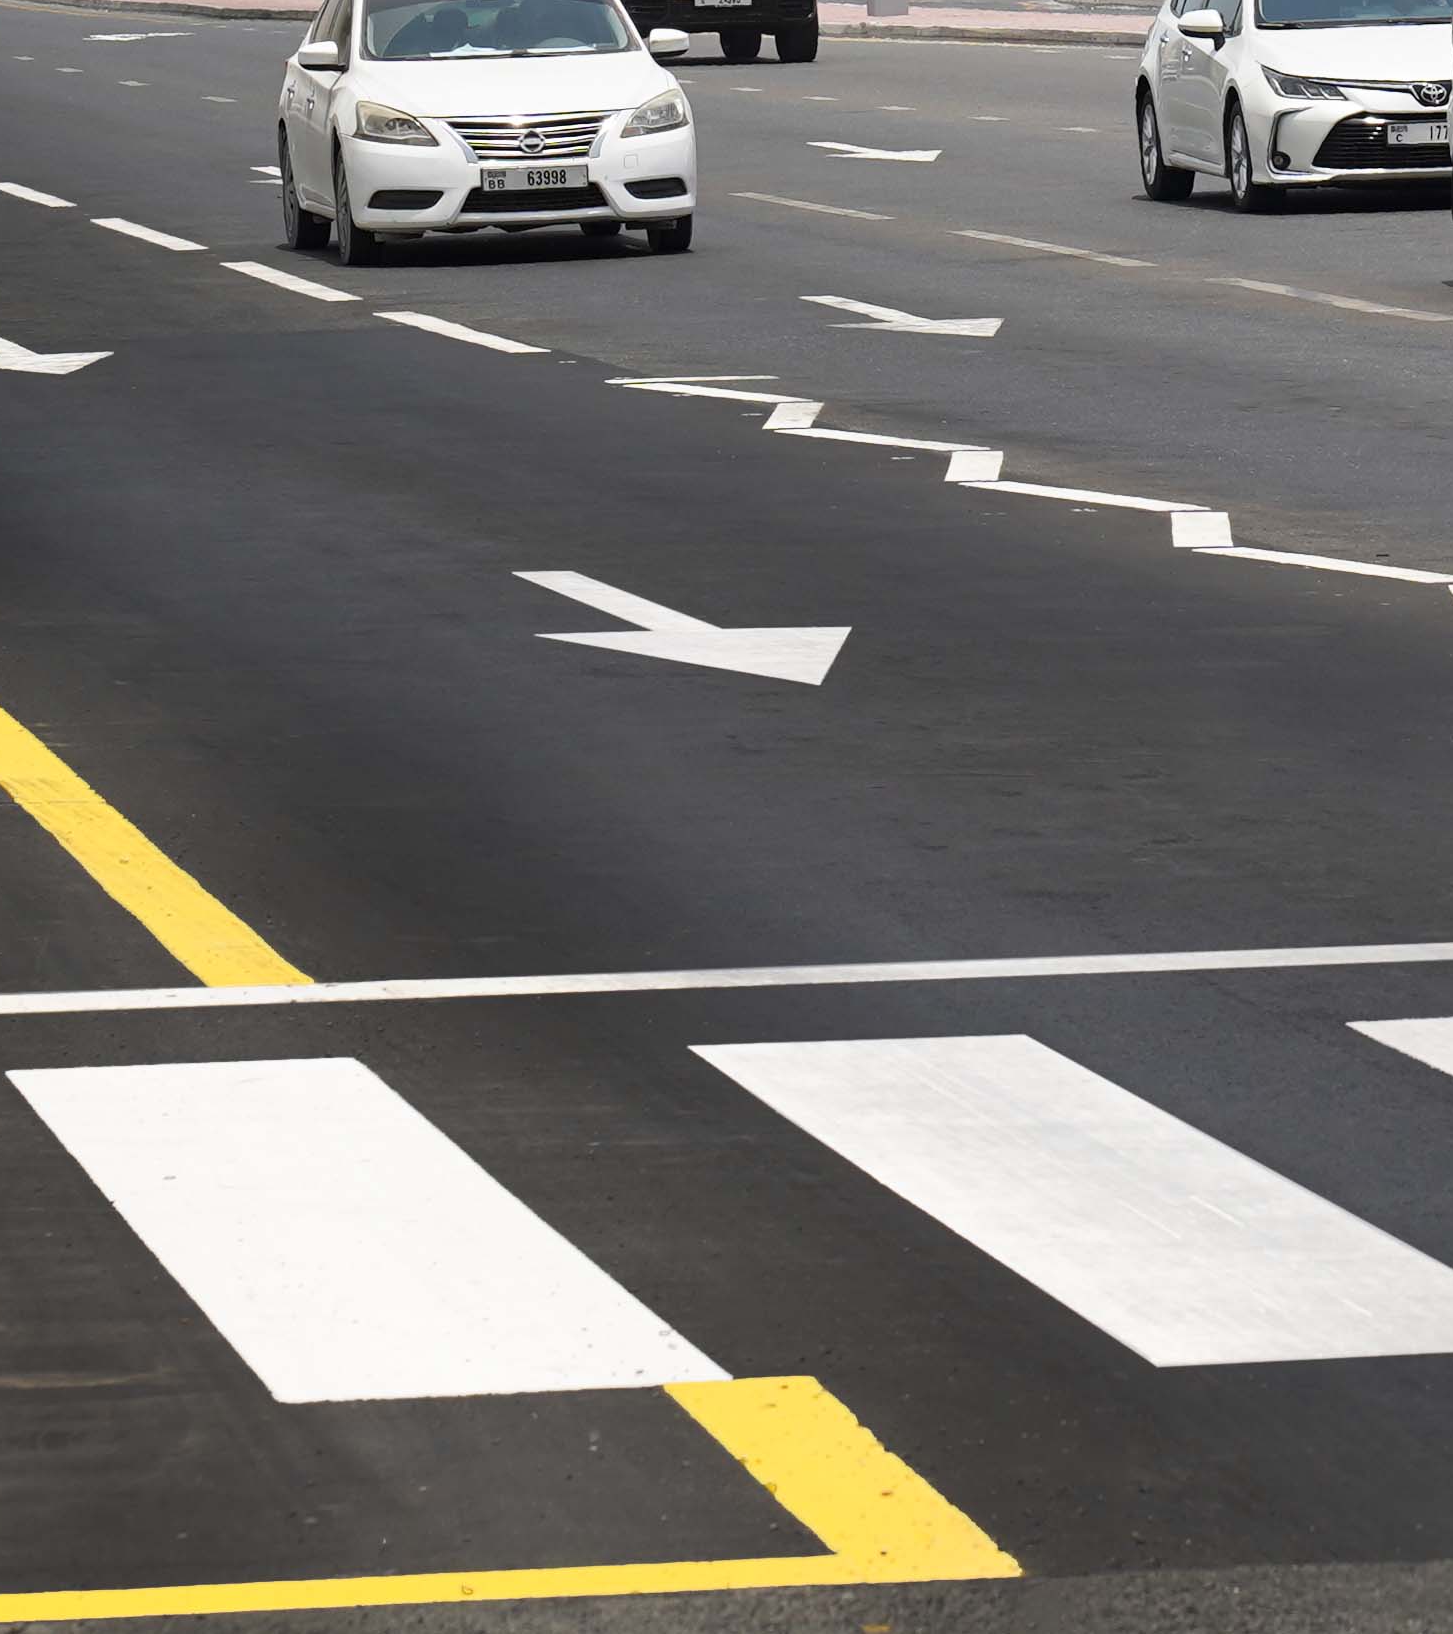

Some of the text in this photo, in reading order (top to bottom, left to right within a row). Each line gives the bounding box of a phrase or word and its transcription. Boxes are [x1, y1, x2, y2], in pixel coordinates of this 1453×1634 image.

[1396, 133, 1403, 142] C
[527, 169, 567, 186] 63998
[488, 178, 505, 189] BB
